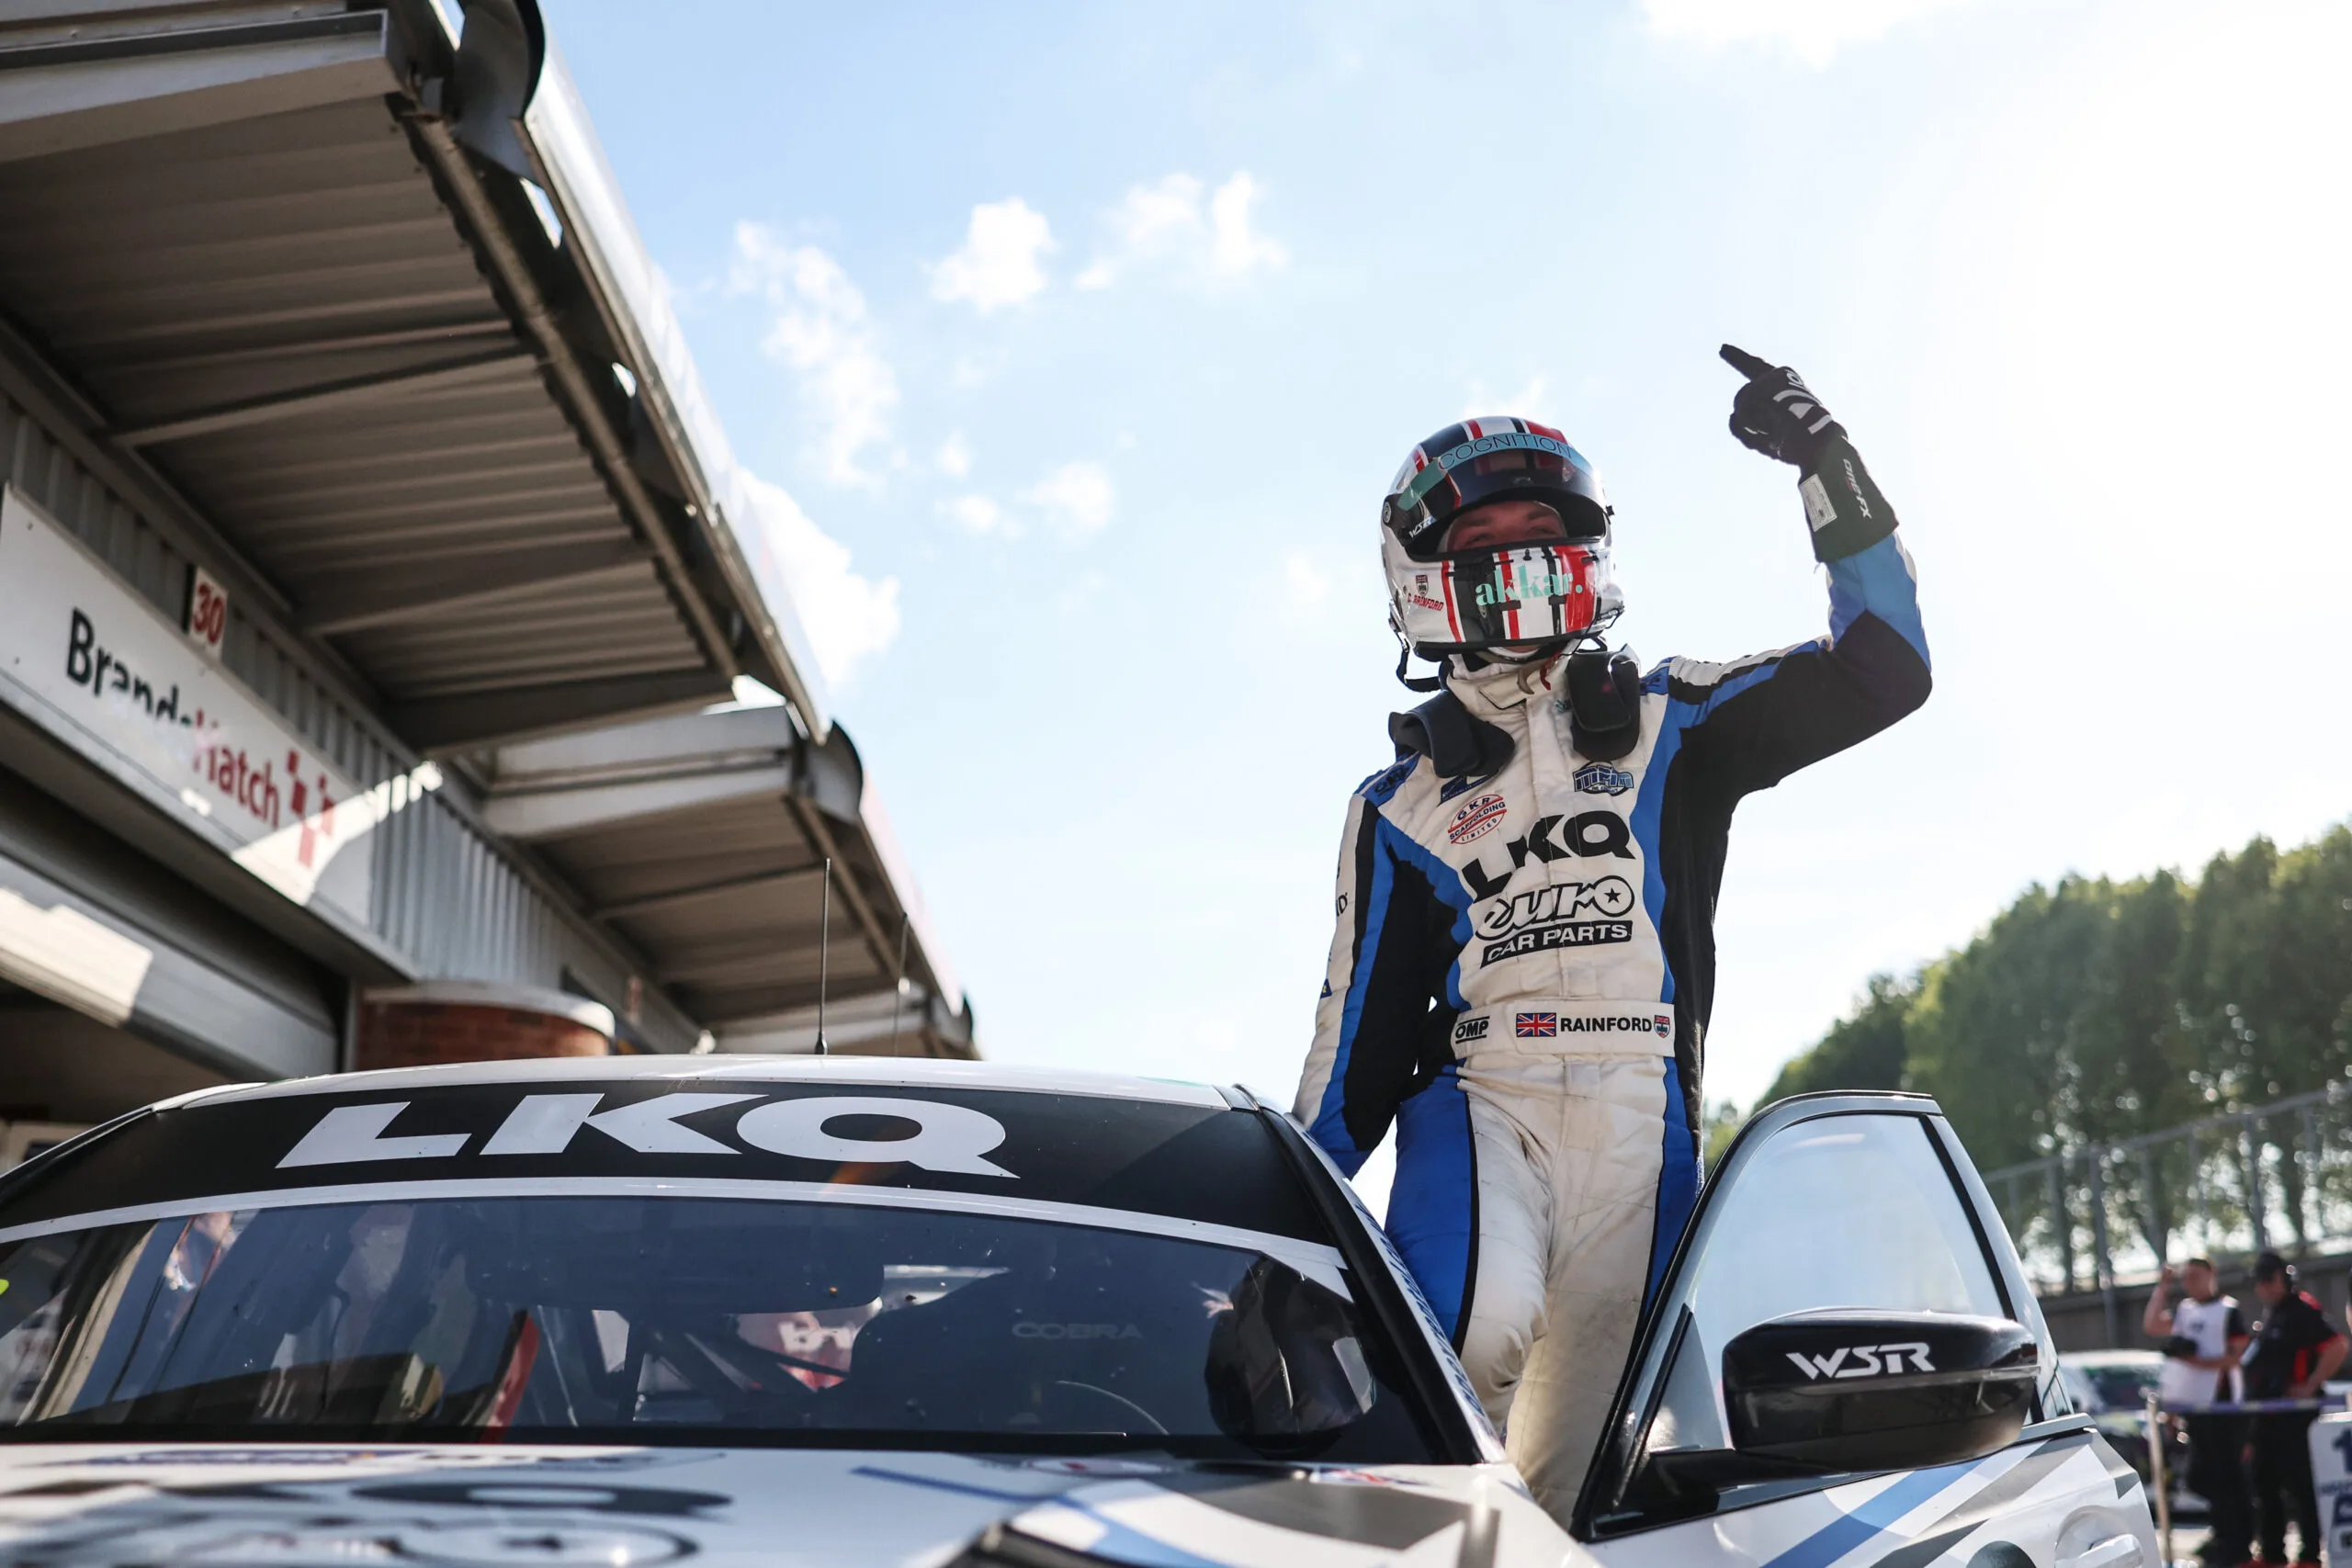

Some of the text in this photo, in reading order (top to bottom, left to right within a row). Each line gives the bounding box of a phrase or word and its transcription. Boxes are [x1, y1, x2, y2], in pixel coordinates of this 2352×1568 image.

[1438, 434, 1573, 471] COGNITION
[193, 582, 226, 645] 30
[1449, 801, 1506, 840] SCAFFOLDING
[1462, 818, 1498, 841] LIMITED
[1461, 810, 1636, 904] LKQ
[1487, 924, 1629, 962] CAR PARTS
[1455, 1019, 1490, 1040] OMP
[1560, 1017, 1652, 1032] RAINFORD
[275, 1093, 1021, 1179] LKQ
[1012, 1321, 1144, 1340] COBRA
[1785, 1341, 1937, 1381] WSR
